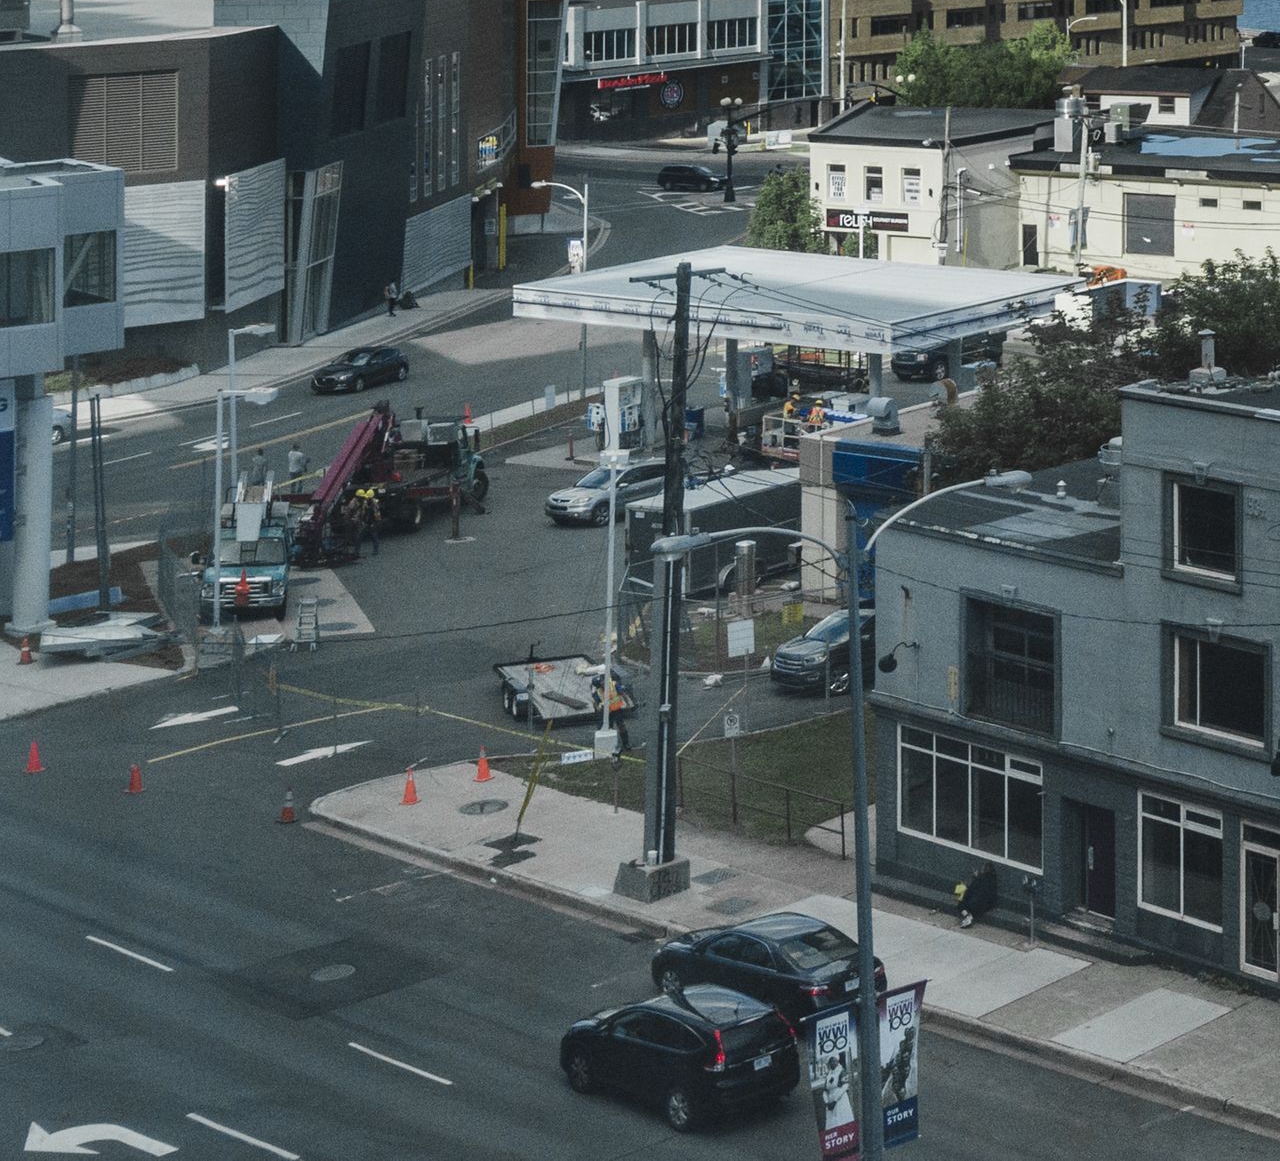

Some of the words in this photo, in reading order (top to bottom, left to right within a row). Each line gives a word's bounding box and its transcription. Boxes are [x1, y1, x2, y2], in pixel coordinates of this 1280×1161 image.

[889, 1012, 911, 1032] 100
[818, 1024, 847, 1041] WWI
[818, 1035, 848, 1055] 100
[886, 1107, 899, 1117] OUR
[887, 1108, 914, 1126] STORY
[825, 1132, 837, 1141] HER
[825, 1132, 855, 1151] STORY
